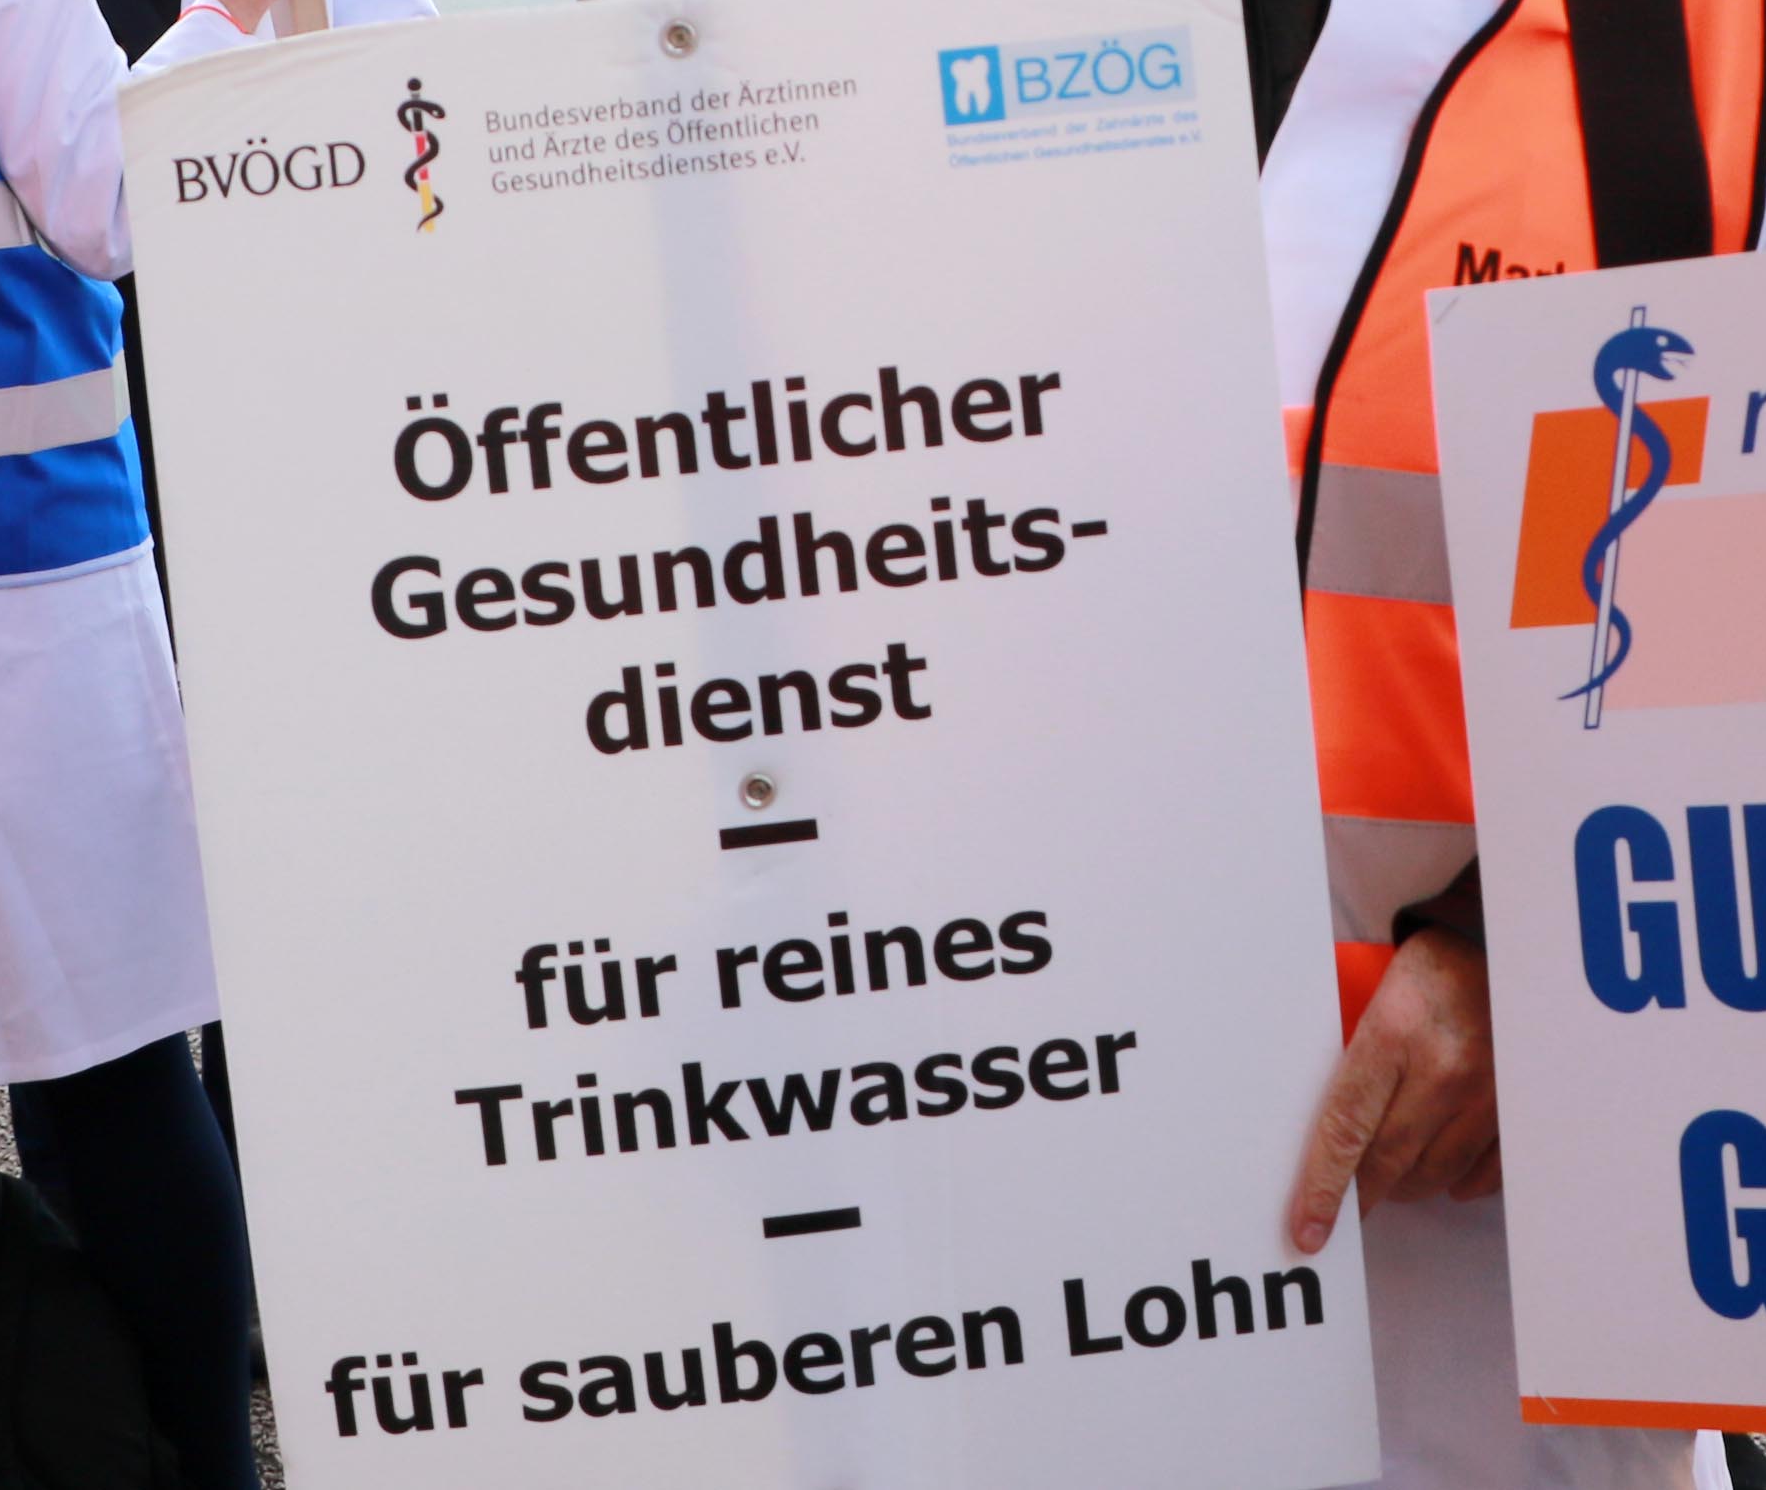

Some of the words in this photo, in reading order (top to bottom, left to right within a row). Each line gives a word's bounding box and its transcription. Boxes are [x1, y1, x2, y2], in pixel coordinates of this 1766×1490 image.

[484, 91, 685, 134] Bundesverband
[689, 87, 732, 114] der
[738, 74, 859, 107] Ärztinnen
[1014, 39, 1183, 104] BZÖG
[172, 138, 366, 204] BVÖGD
[488, 137, 535, 165] und
[542, 129, 607, 161] Ärzte
[613, 125, 660, 152] des
[666, 110, 820, 148] Öffentlichen
[491, 147, 758, 195] Gesundheitsdienstes
[764, 140, 807, 167] e.V.
[392, 366, 1062, 502] Öffentlicher
[370, 495, 1109, 640] Gesundheits-
[585, 643, 932, 755] dienst
[515, 936, 677, 1030] für
[716, 908, 1053, 1011] reines
[454, 1030, 1139, 1168] Trinkwasser
[325, 1351, 485, 1440] für
[519, 1301, 1026, 1425] sauberen
[1062, 1257, 1326, 1358] Lohn
